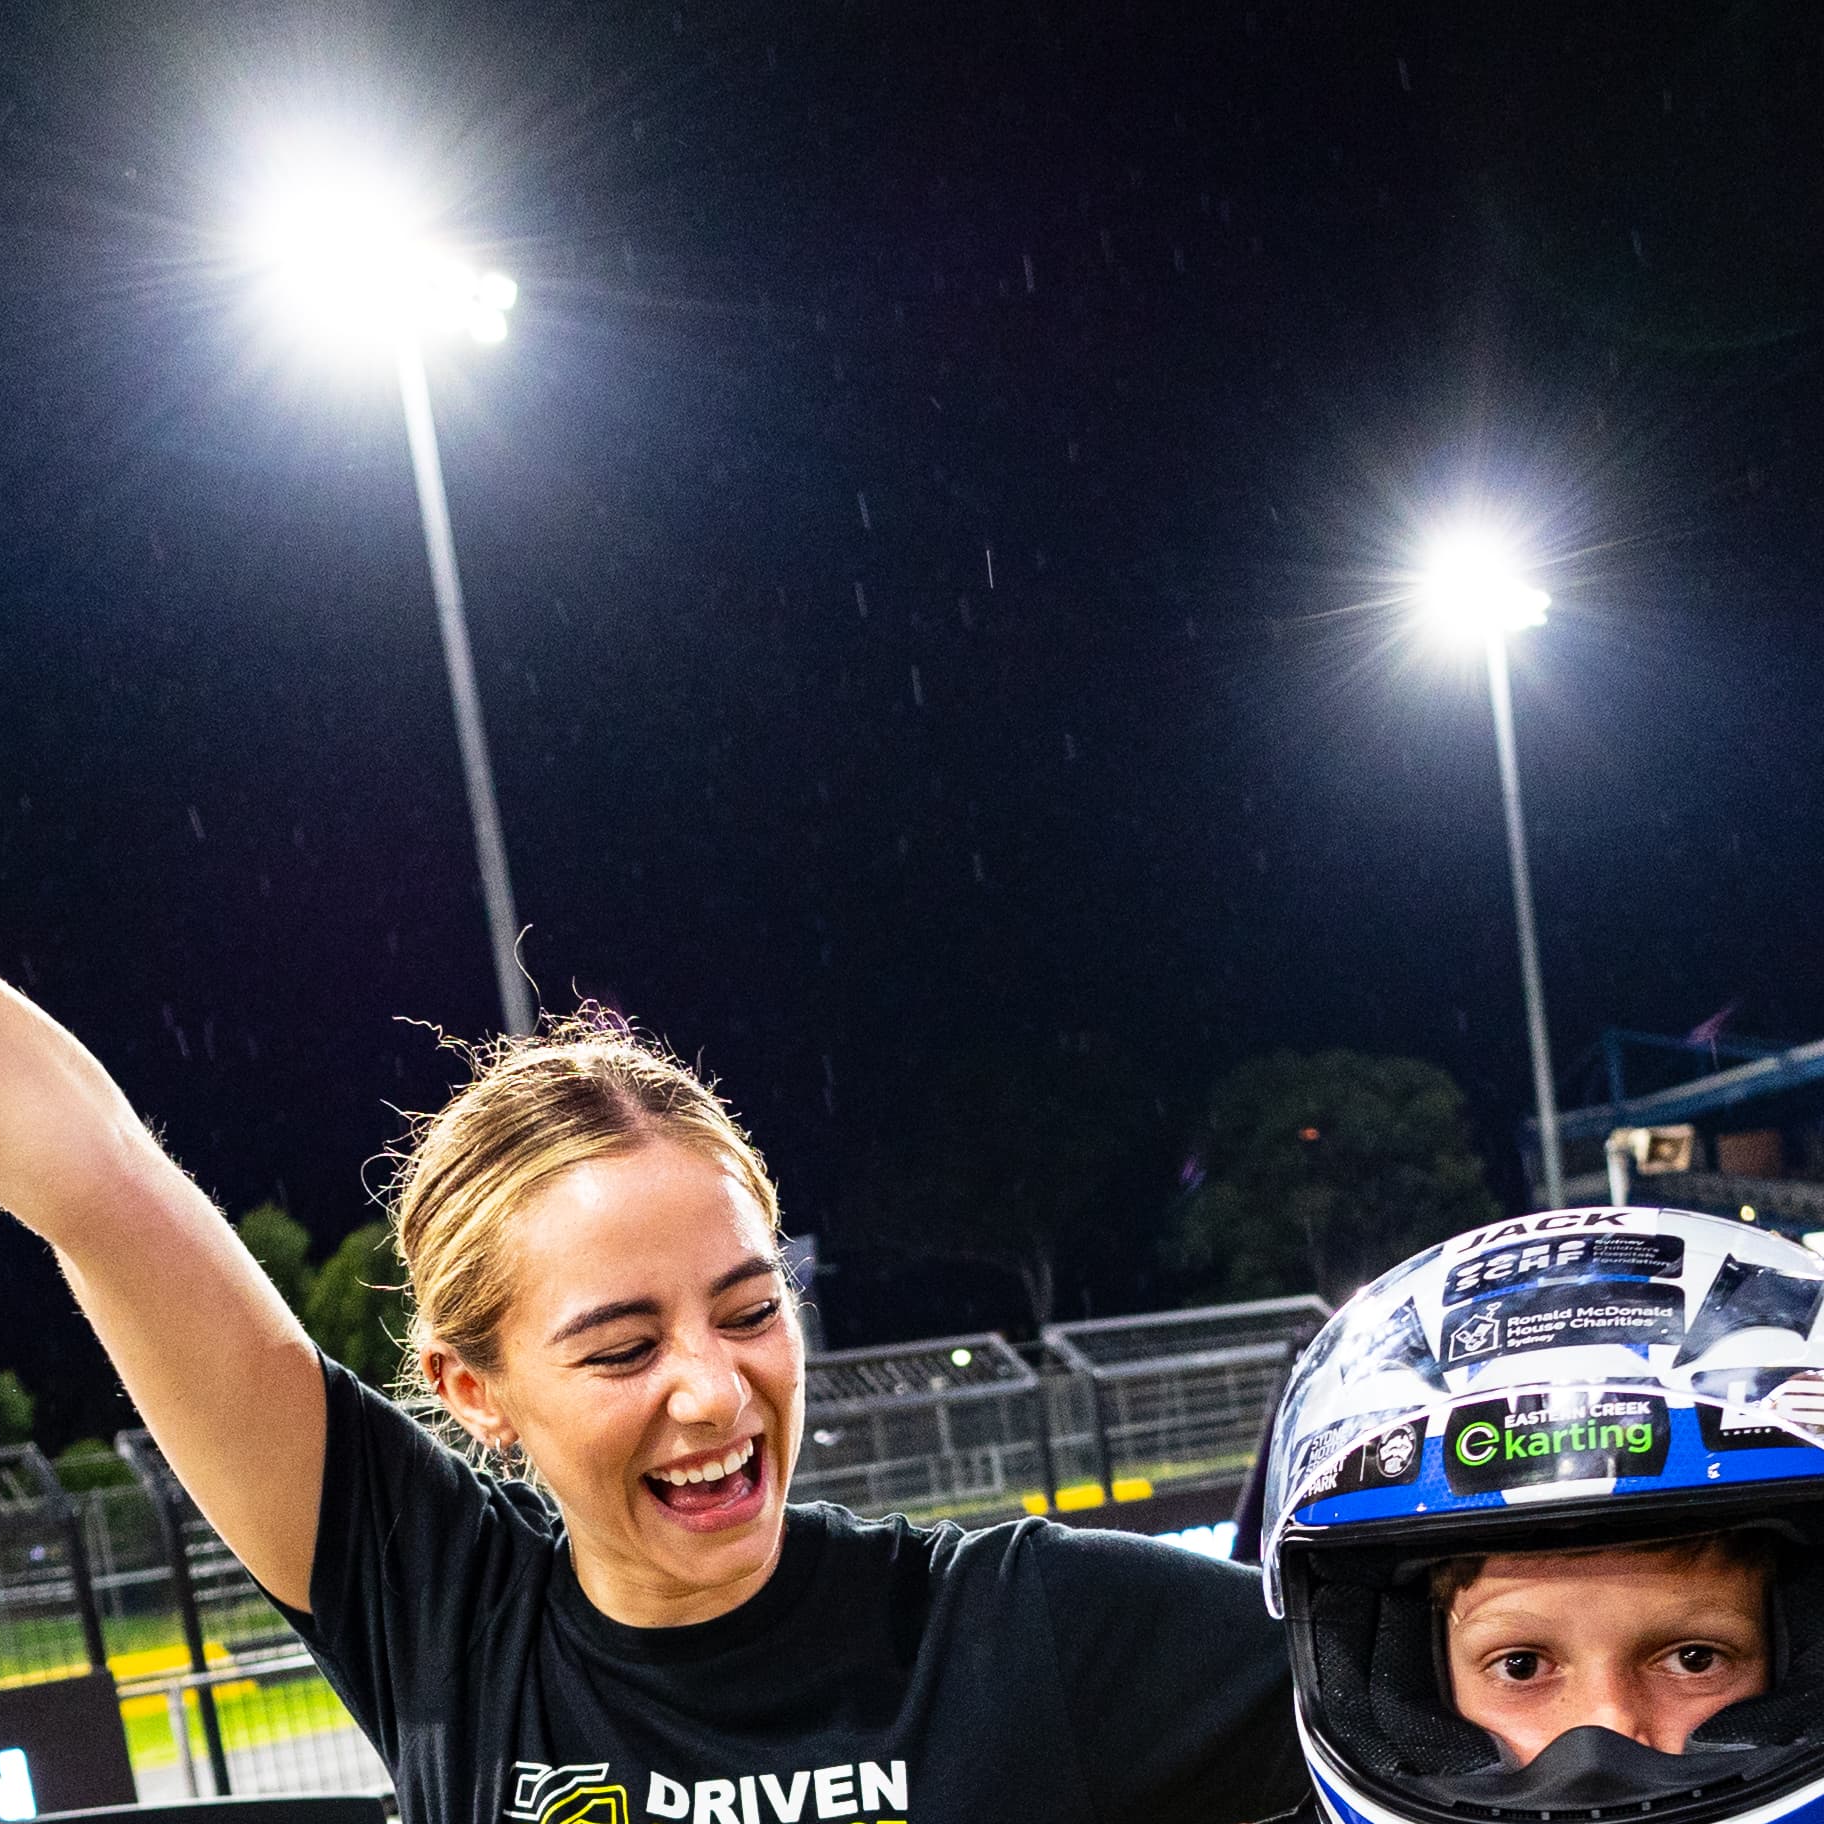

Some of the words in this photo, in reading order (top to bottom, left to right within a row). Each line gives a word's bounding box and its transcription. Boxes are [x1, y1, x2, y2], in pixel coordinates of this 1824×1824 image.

[1457, 1212, 1632, 1255] JACK
[1456, 1248, 1586, 1292] SCHF
[1506, 1320, 1567, 1338] House
[1569, 1316, 1656, 1329] Charities
[1507, 1308, 1573, 1328] Ronald
[1576, 1306, 1674, 1318] McDonald
[1506, 1333, 1556, 1348] Sydney
[1589, 1400, 1652, 1418] CREEK
[1504, 1418, 1653, 1461] karting
[1308, 1471, 1338, 1497] PARK
